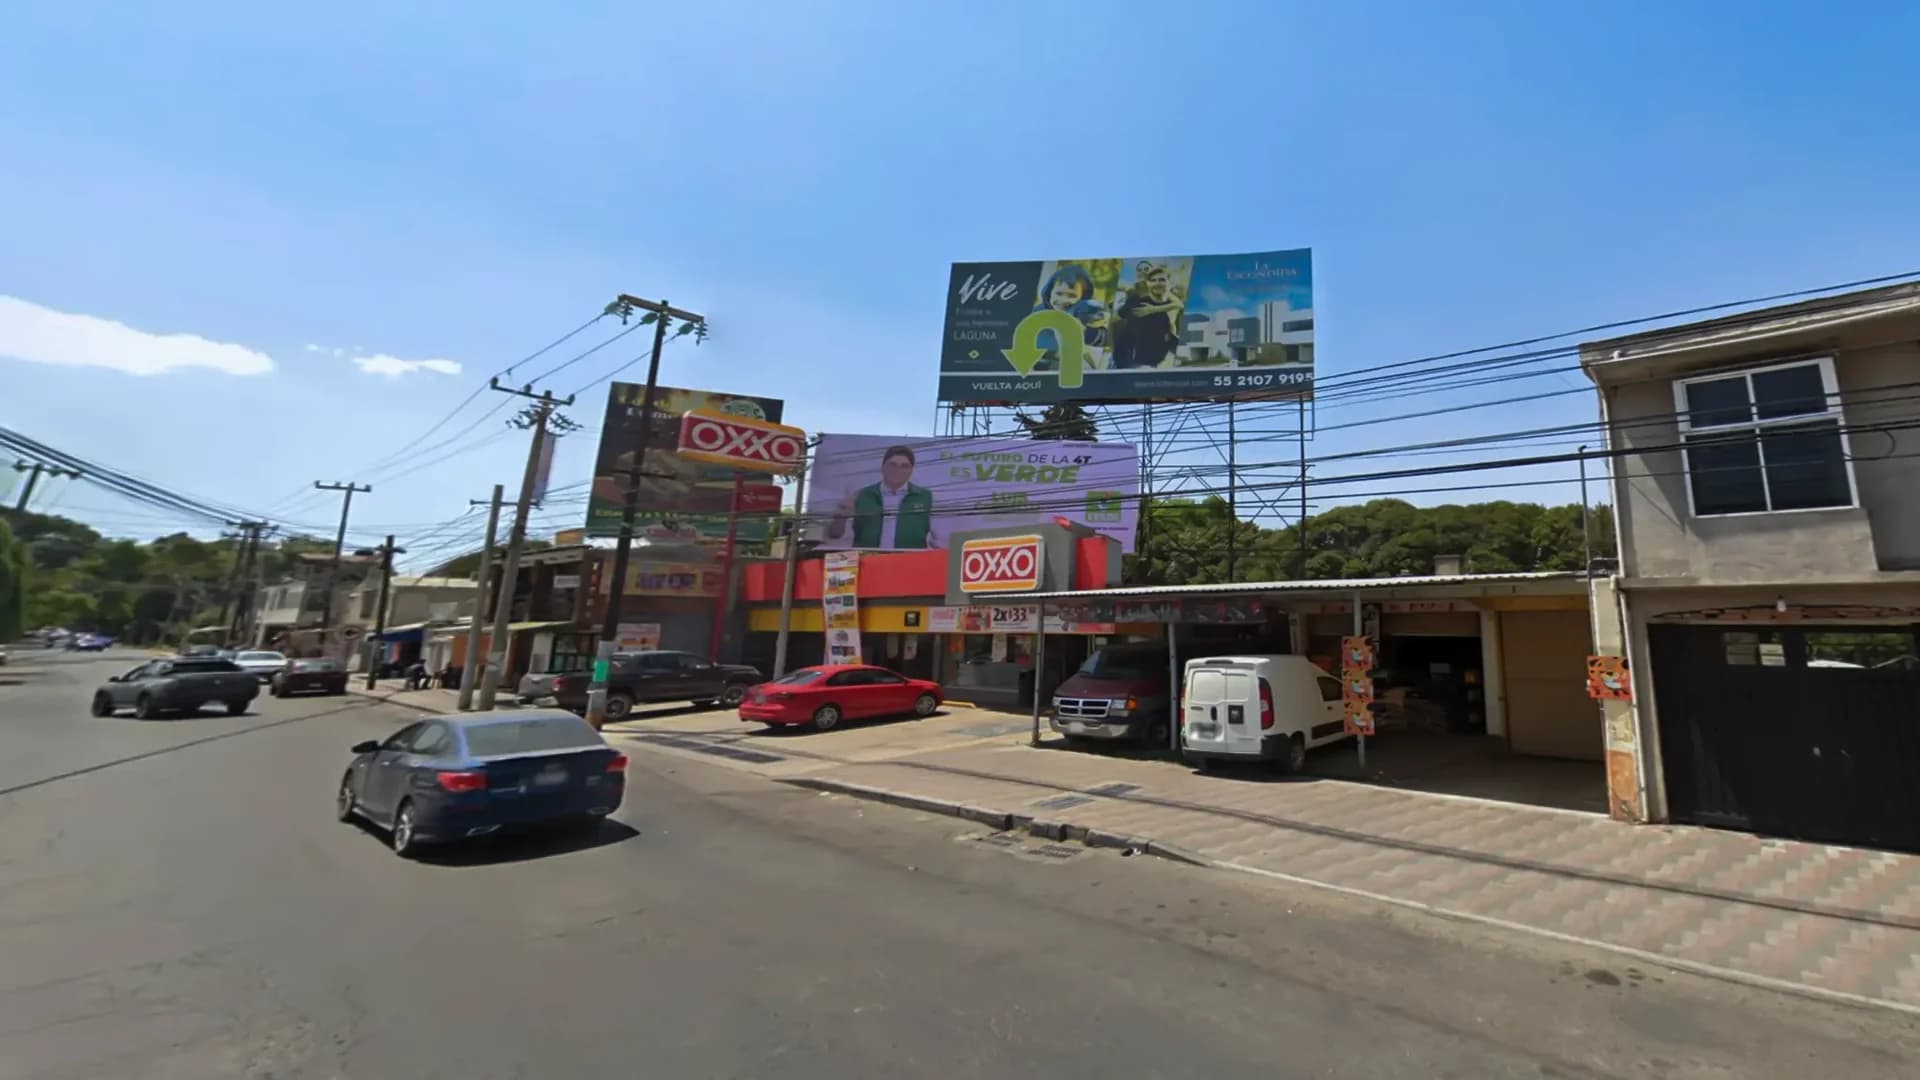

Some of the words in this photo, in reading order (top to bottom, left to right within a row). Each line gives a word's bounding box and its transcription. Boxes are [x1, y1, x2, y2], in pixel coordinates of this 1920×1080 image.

[957, 272, 1019, 305] Vive
[953, 329, 997, 341] LAGUNA
[972, 381, 1012, 391] VUELTA
[1014, 380, 1041, 391] AQUÍ
[1213, 375, 1231, 387] 55
[1237, 374, 1273, 387] 2107
[1278, 372, 1314, 385] 9195
[692, 421, 801, 463] OXXO
[1028, 453, 1048, 464] DE
[1052, 454, 1069, 464] LA
[1073, 455, 1092, 465] 4T
[976, 463, 1080, 484] VERDE
[965, 546, 1034, 583] OXXO
